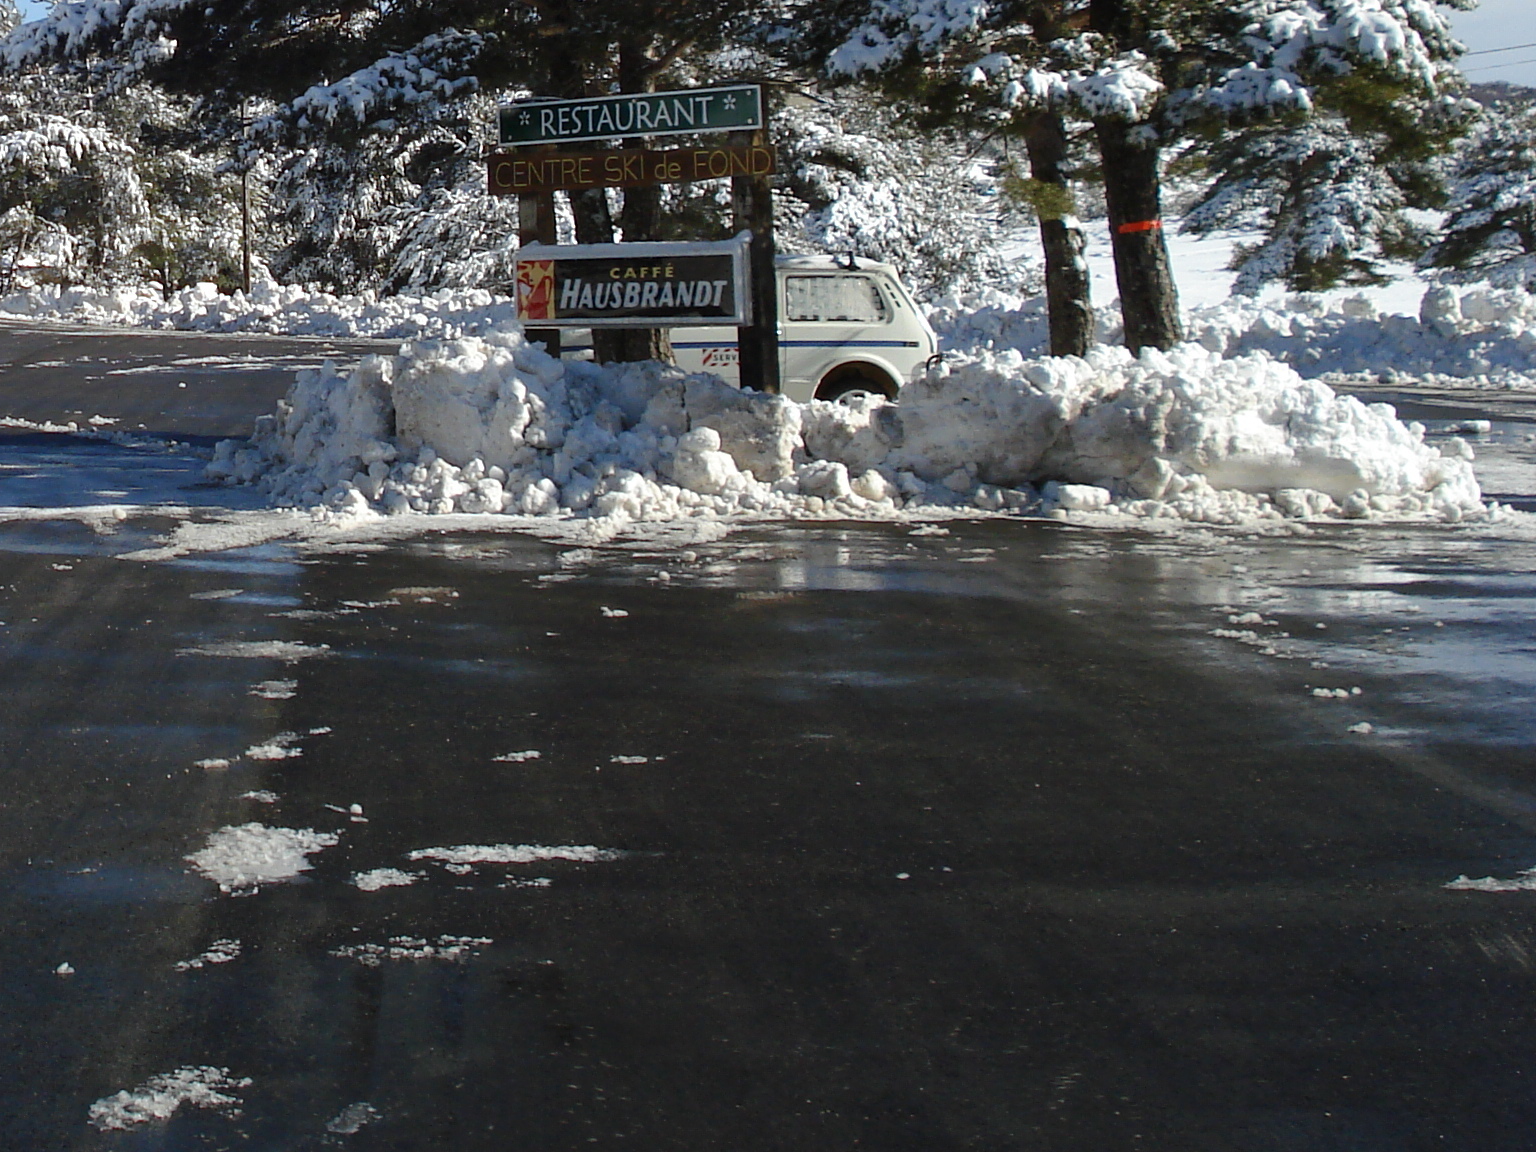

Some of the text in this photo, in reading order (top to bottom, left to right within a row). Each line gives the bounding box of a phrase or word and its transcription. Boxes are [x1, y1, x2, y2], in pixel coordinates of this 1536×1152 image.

[540, 96, 714, 136] RESTAURANT
[495, 148, 772, 188] CENTRE SKI de FOND
[609, 263, 675, 279] CAFFÉ
[560, 278, 728, 309] HAUSBRANDT
